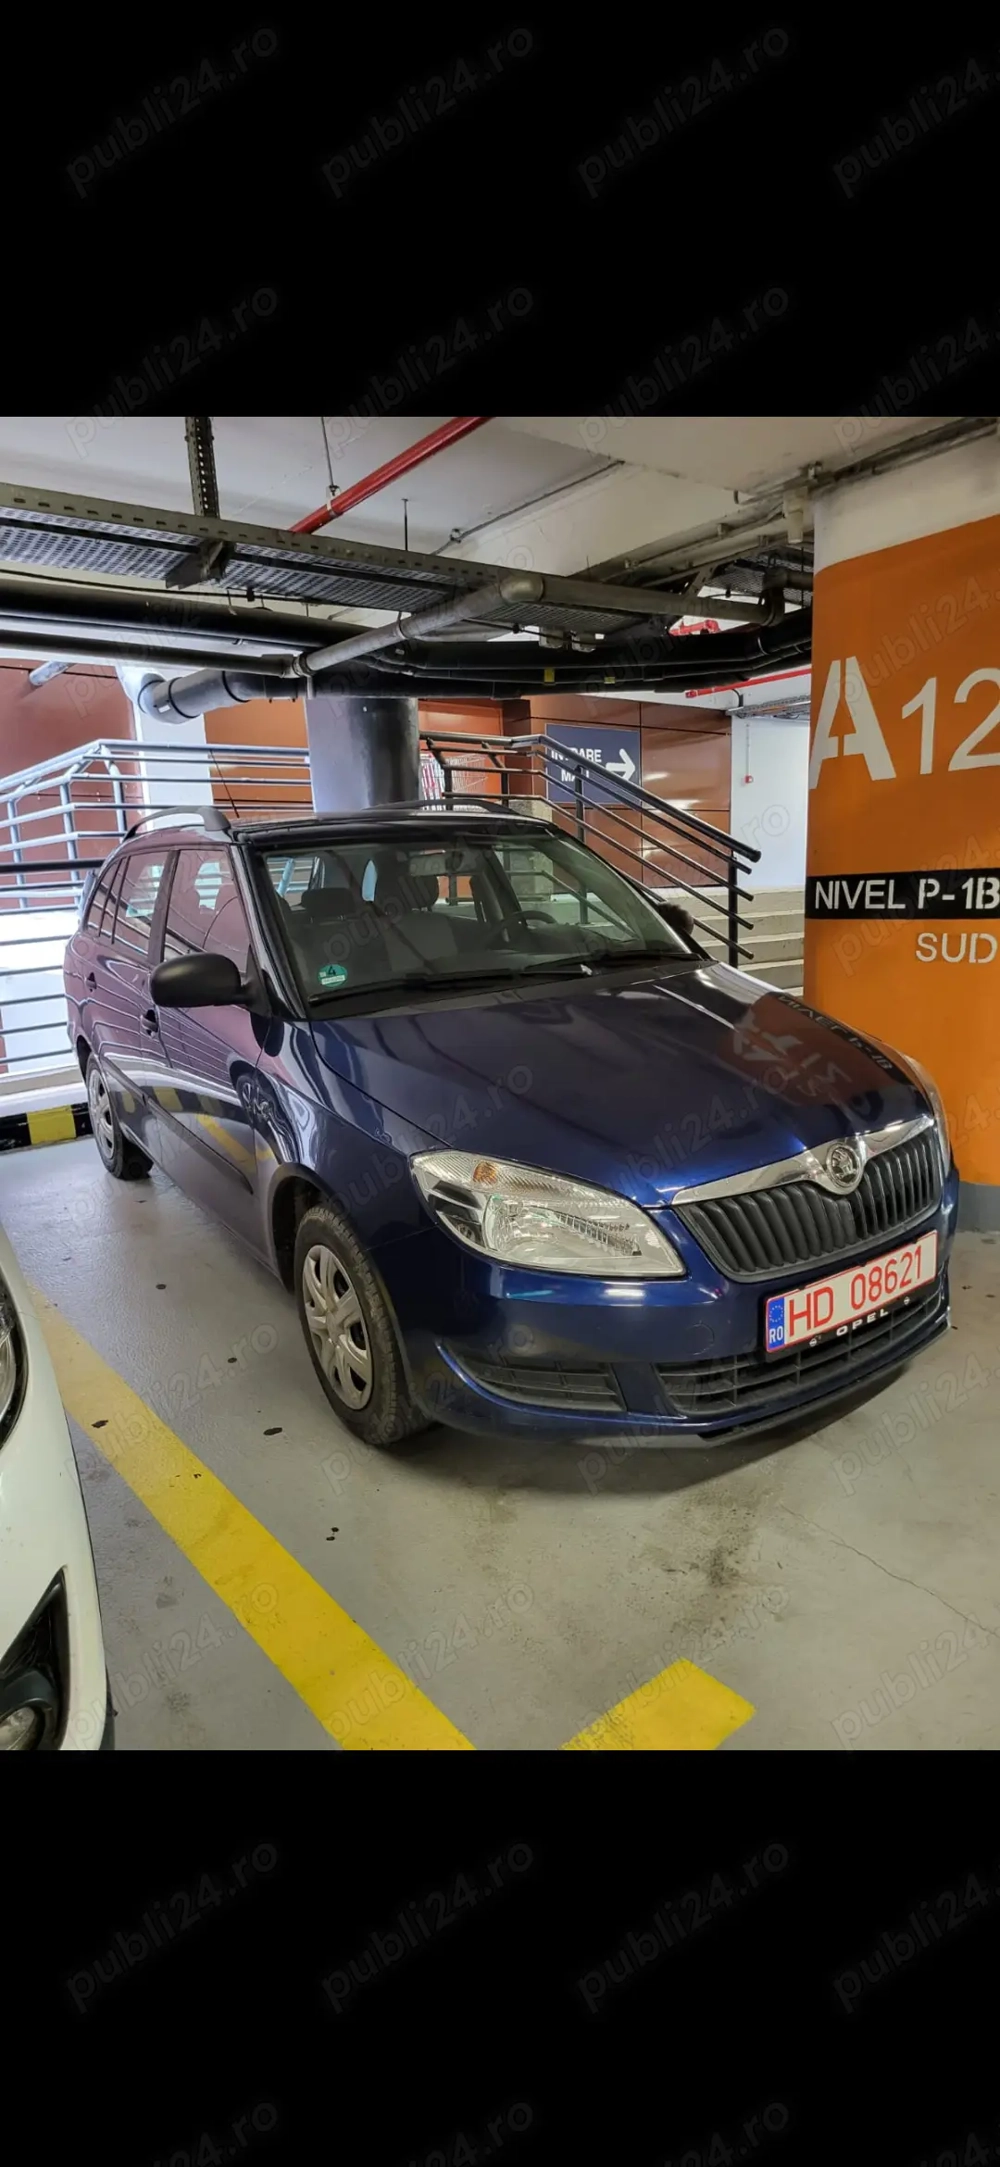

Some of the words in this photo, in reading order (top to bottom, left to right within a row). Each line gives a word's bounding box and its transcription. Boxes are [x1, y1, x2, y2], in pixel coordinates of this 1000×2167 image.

[815, 878, 906, 910] NIVEL
[917, 876, 1000, 910] P-1B
[915, 932, 998, 964] SUD
[789, 1286, 834, 1337] HD
[850, 1245, 922, 1310] 08621
[769, 1325, 784, 1344] RO
[836, 1308, 889, 1336] OPEL
